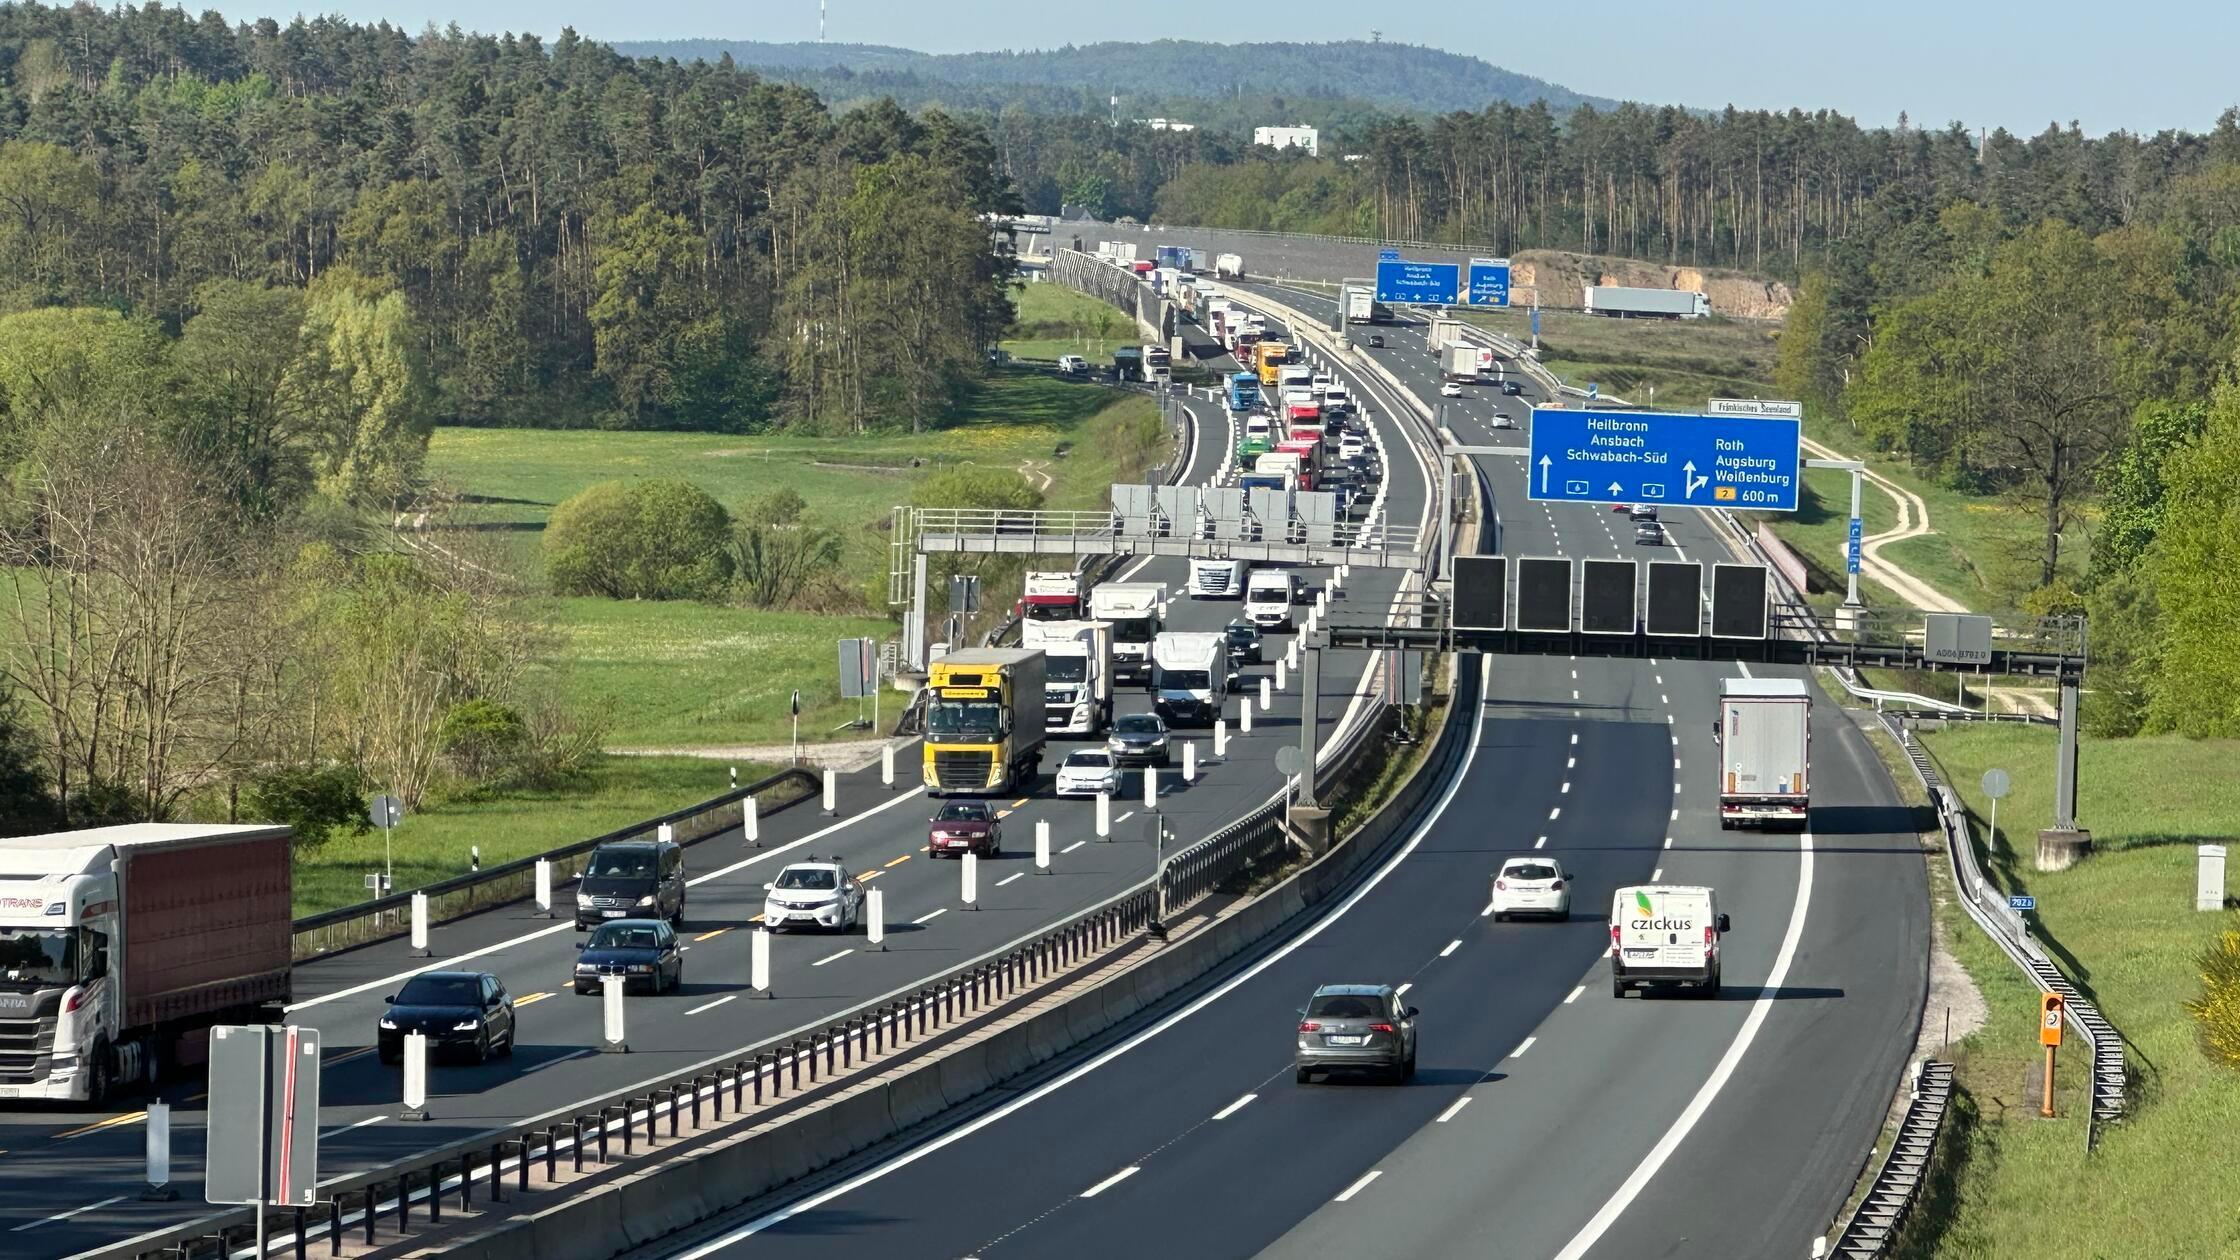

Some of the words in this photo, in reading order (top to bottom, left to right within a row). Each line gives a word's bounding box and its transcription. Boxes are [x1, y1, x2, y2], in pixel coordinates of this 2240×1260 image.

[1587, 418, 1649, 432] Heilbronn
[1590, 434, 1645, 447] Ansbach
[1715, 438, 1745, 451] Roth
[1567, 448, 1668, 464] Schwabach-Süd
[1715, 454, 1777, 471] Augsburg
[1715, 469, 1790, 487] Weißenburg
[1742, 490, 1765, 502] 600
[1767, 493, 1779, 503] m
[0, 897, 44, 908] TRANS
[1631, 916, 1692, 931] czickus
